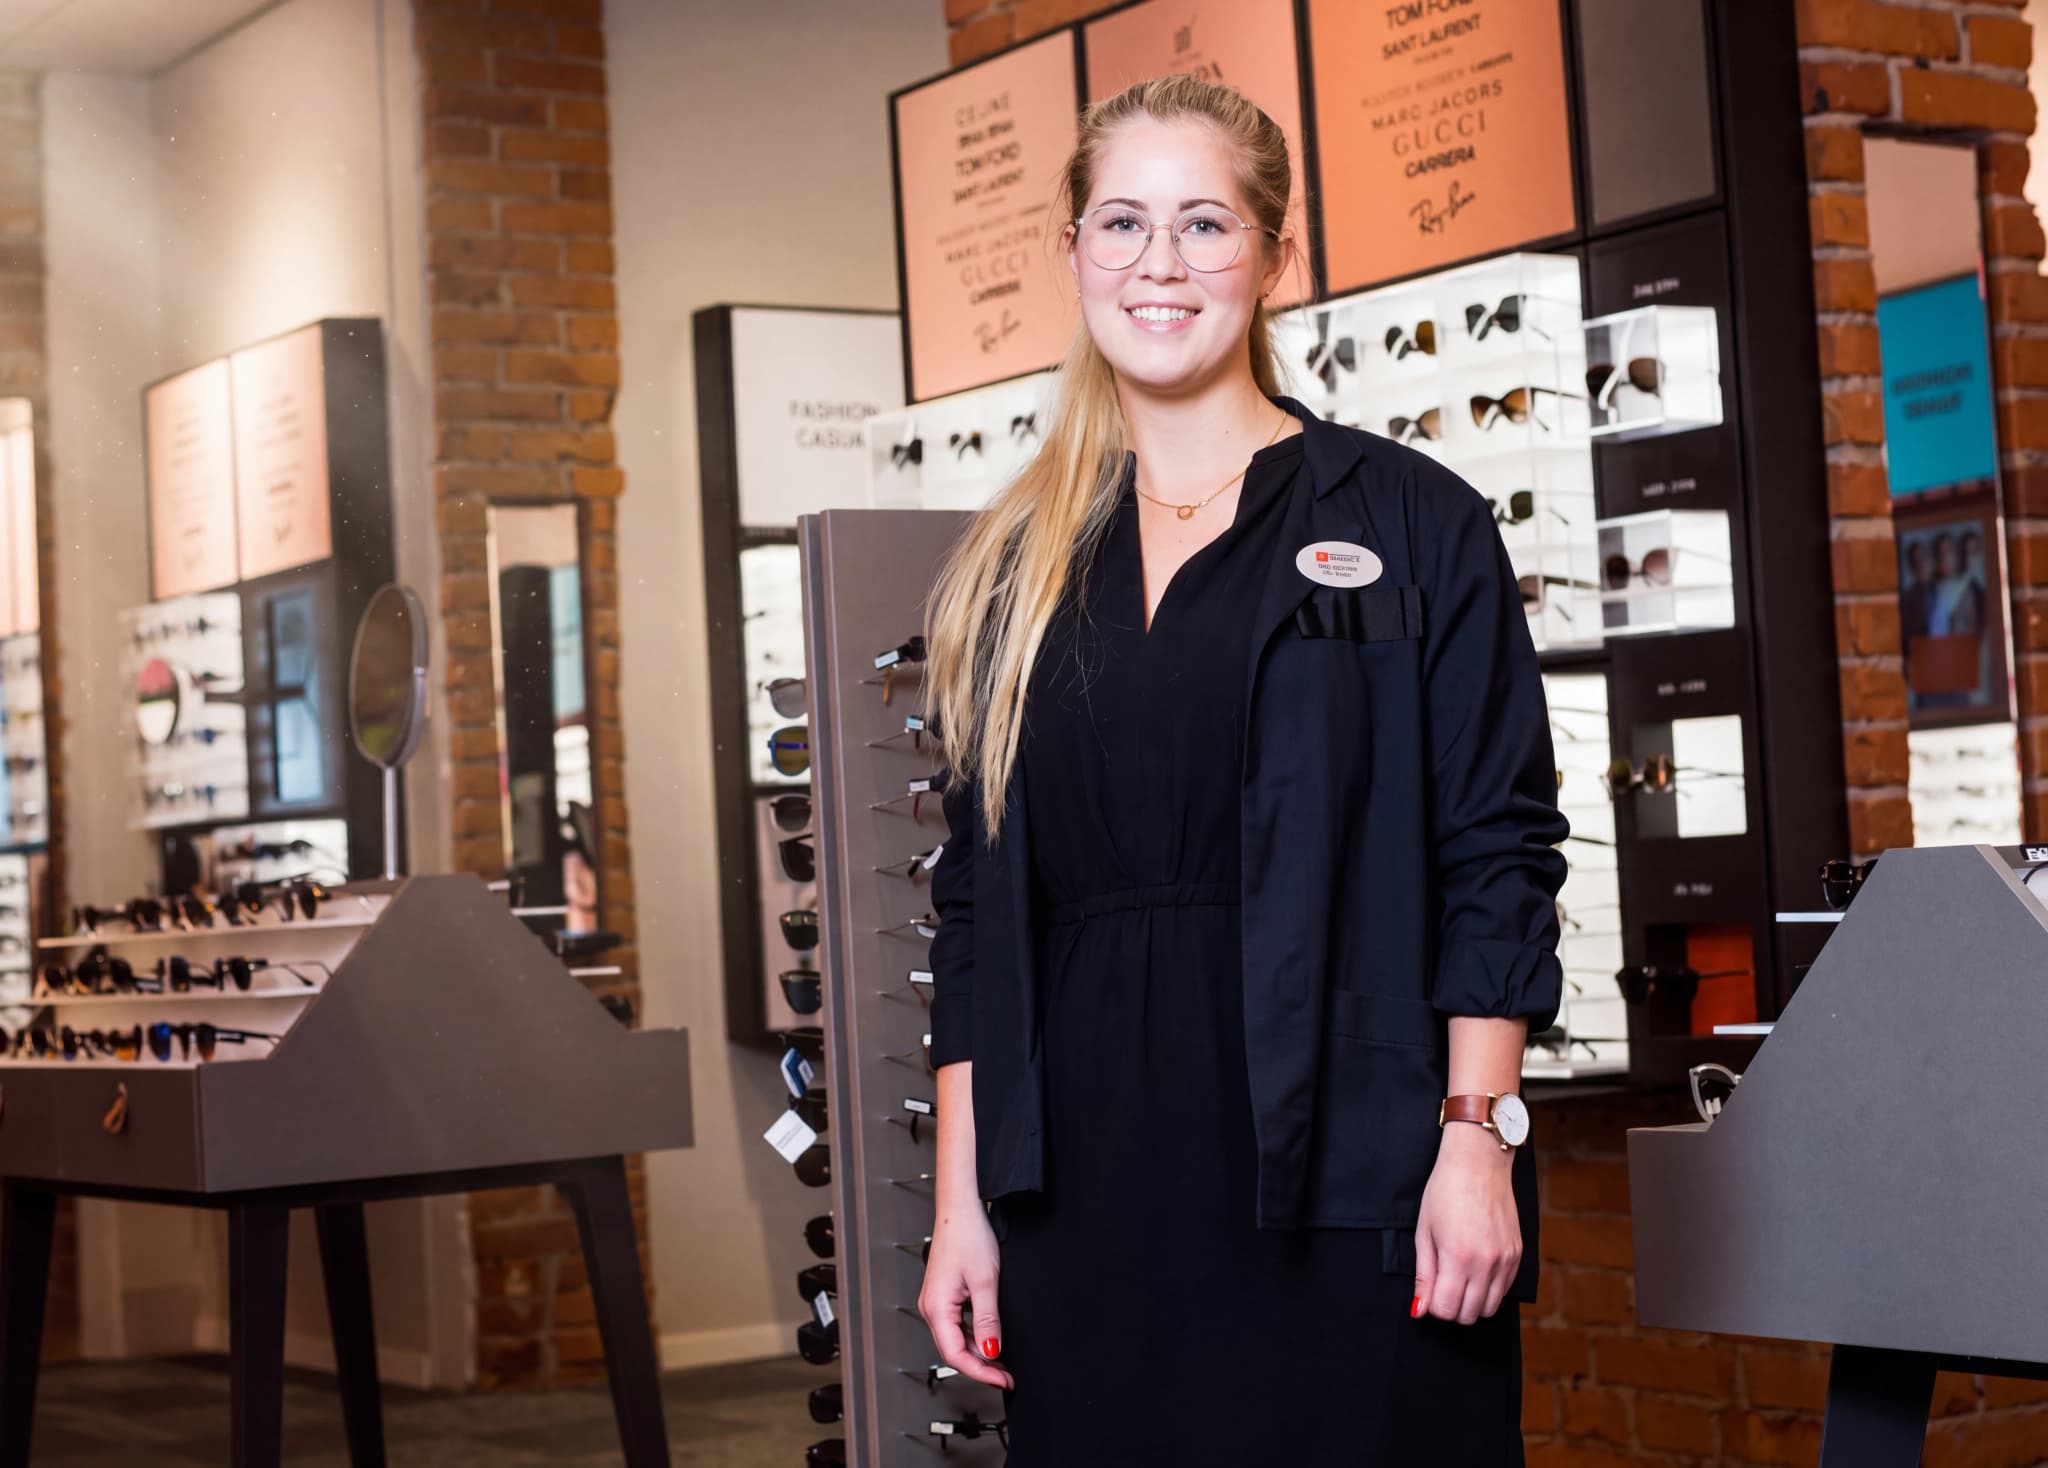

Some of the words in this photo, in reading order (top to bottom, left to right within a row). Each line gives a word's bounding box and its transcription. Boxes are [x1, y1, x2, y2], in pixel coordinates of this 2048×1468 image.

[1386, 0, 1423, 29] TOM
[1372, 103, 1421, 131] MARC
[1392, 108, 1486, 157] GUCCI
[794, 427, 865, 450] CASUA
